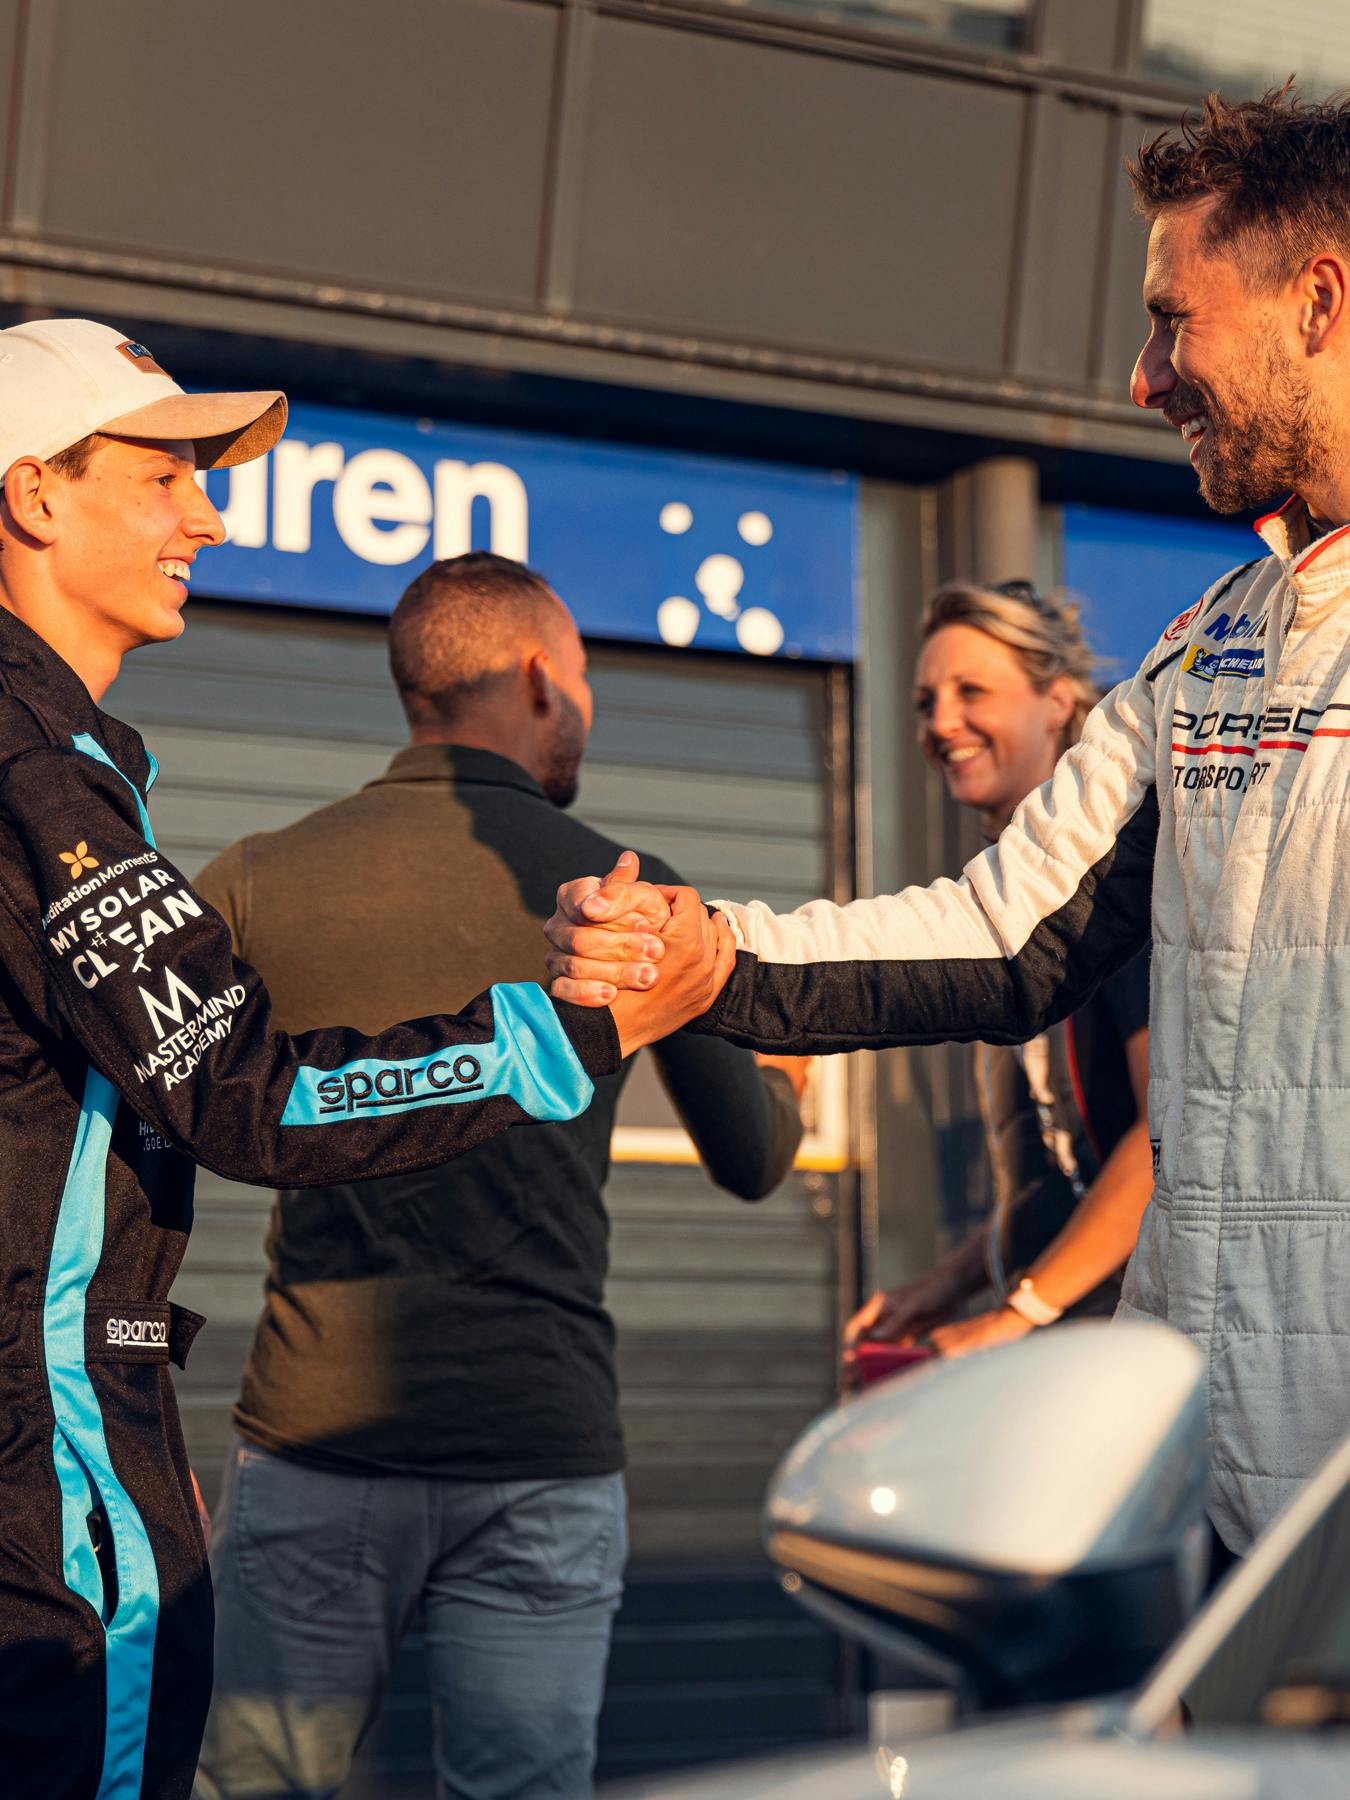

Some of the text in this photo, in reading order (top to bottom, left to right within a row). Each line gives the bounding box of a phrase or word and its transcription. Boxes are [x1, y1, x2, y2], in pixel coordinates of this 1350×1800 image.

[1172, 704, 1350, 740] PORSC
[1174, 762, 1271, 793] TORSPORT
[50, 868, 175, 956] MY SOLAR
[72, 889, 203, 989] CLEAN
[133, 985, 246, 1083] MASTERMIND
[158, 1015, 233, 1091] ACADEMY
[317, 1055, 482, 1112] sparco
[106, 1318, 167, 1347] sparco
